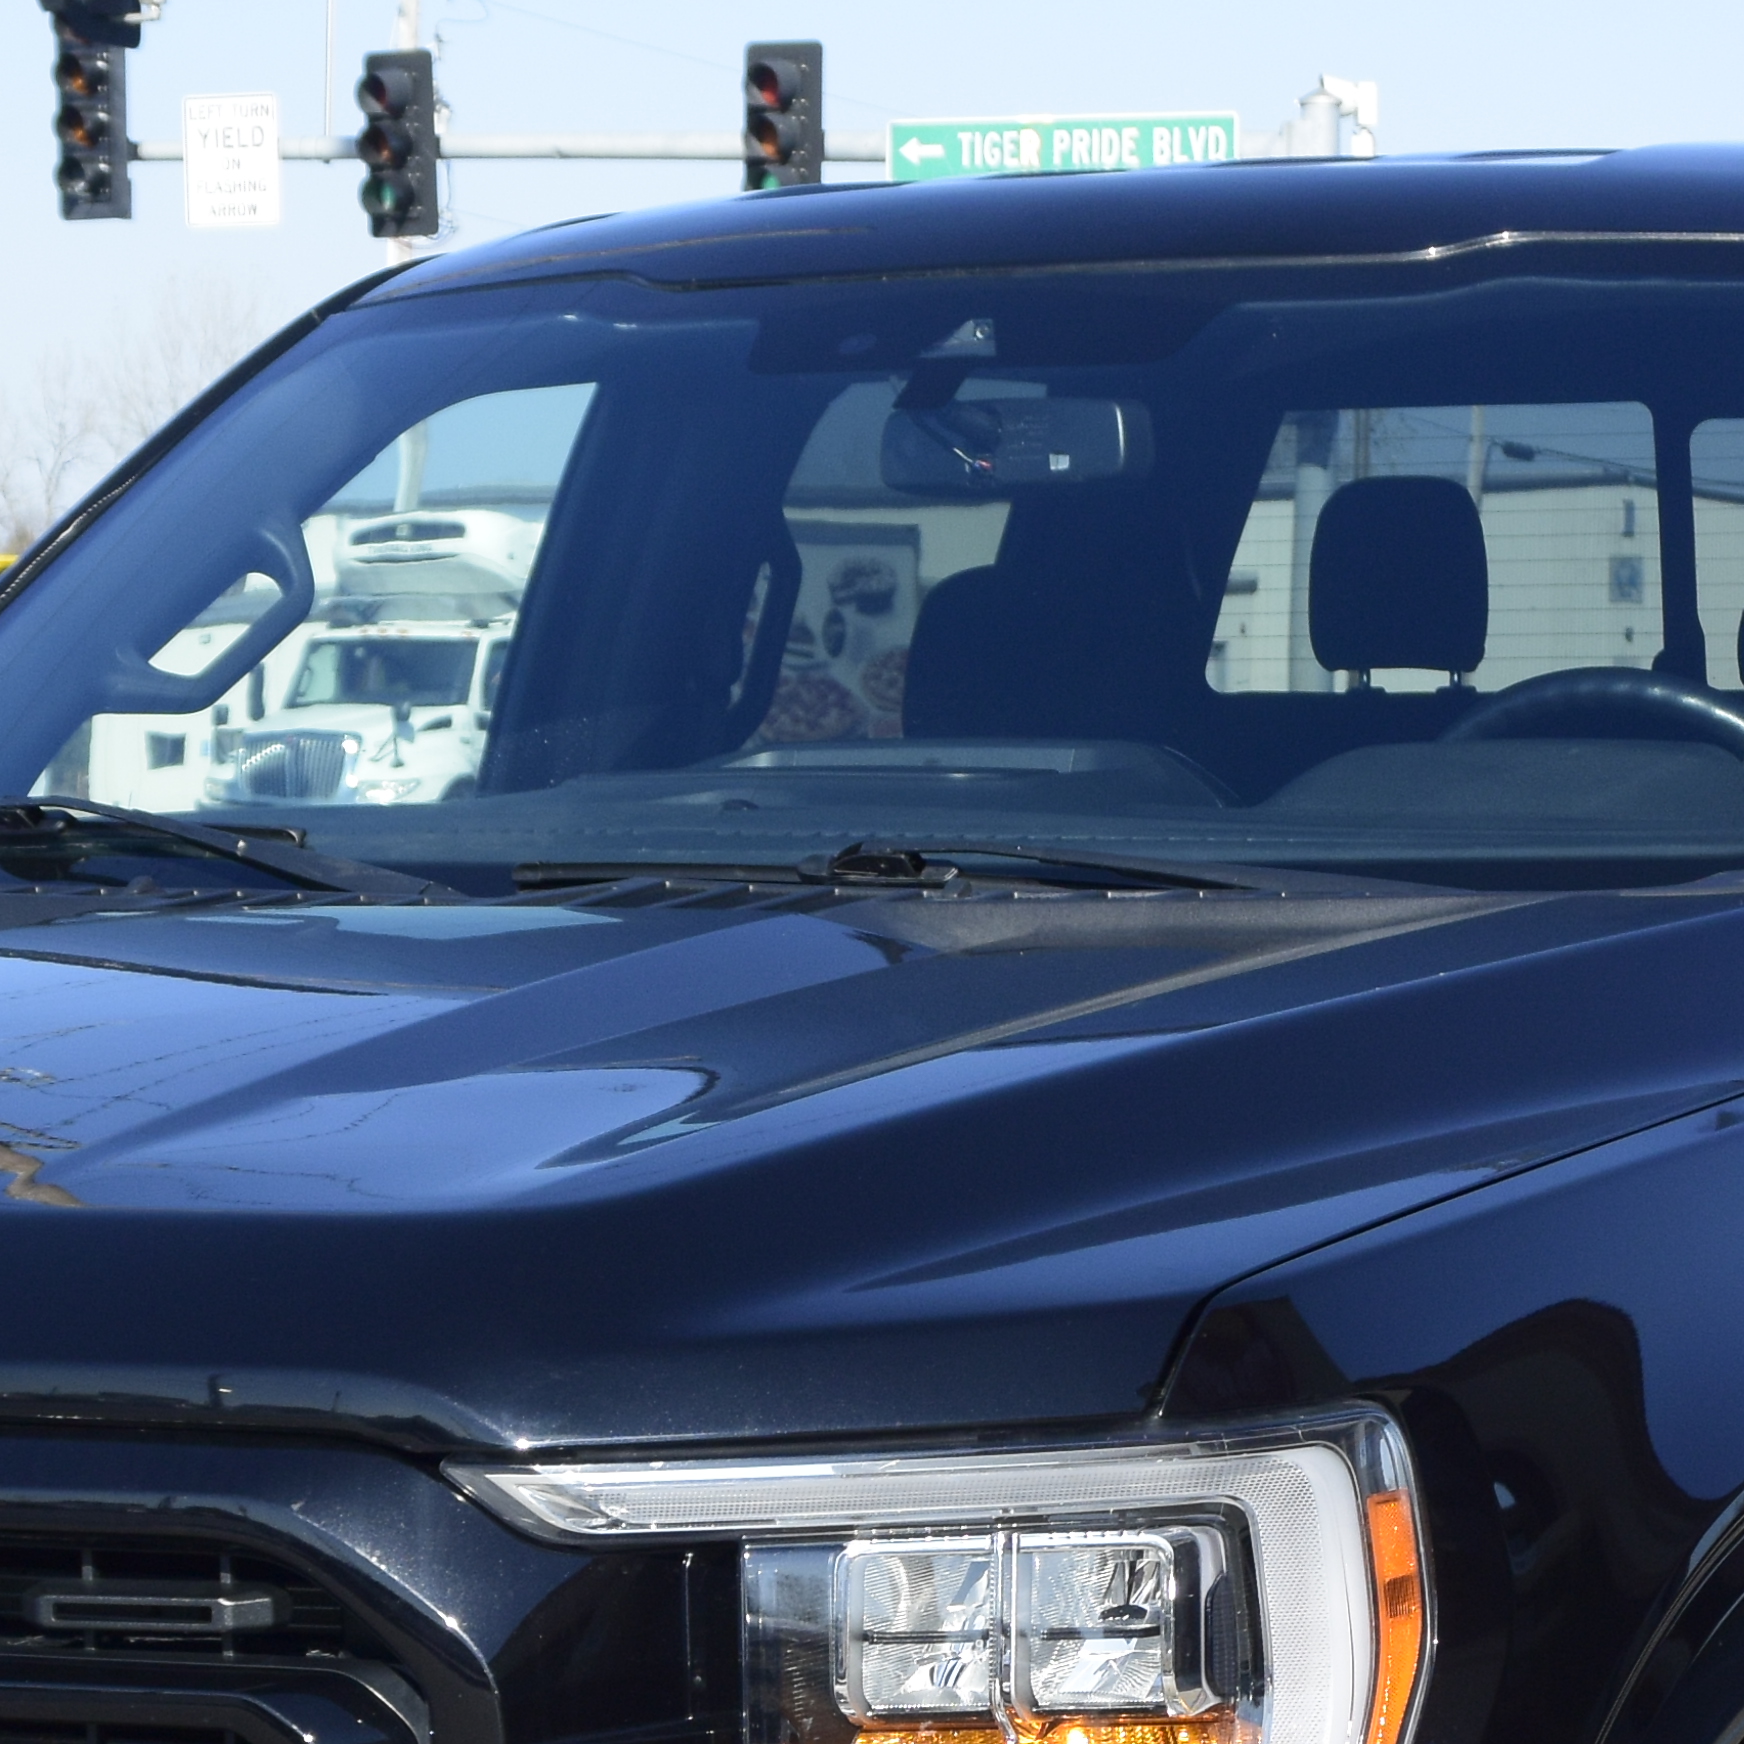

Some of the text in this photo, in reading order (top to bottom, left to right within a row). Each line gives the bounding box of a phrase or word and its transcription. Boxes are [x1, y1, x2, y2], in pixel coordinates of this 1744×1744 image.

[189, 102, 269, 120] LEFT TURN
[198, 125, 265, 149] YIELD
[957, 125, 1228, 168] TIGER PRIDE BLVD
[197, 179, 267, 194] FLASHING
[210, 202, 258, 217] ARROW
